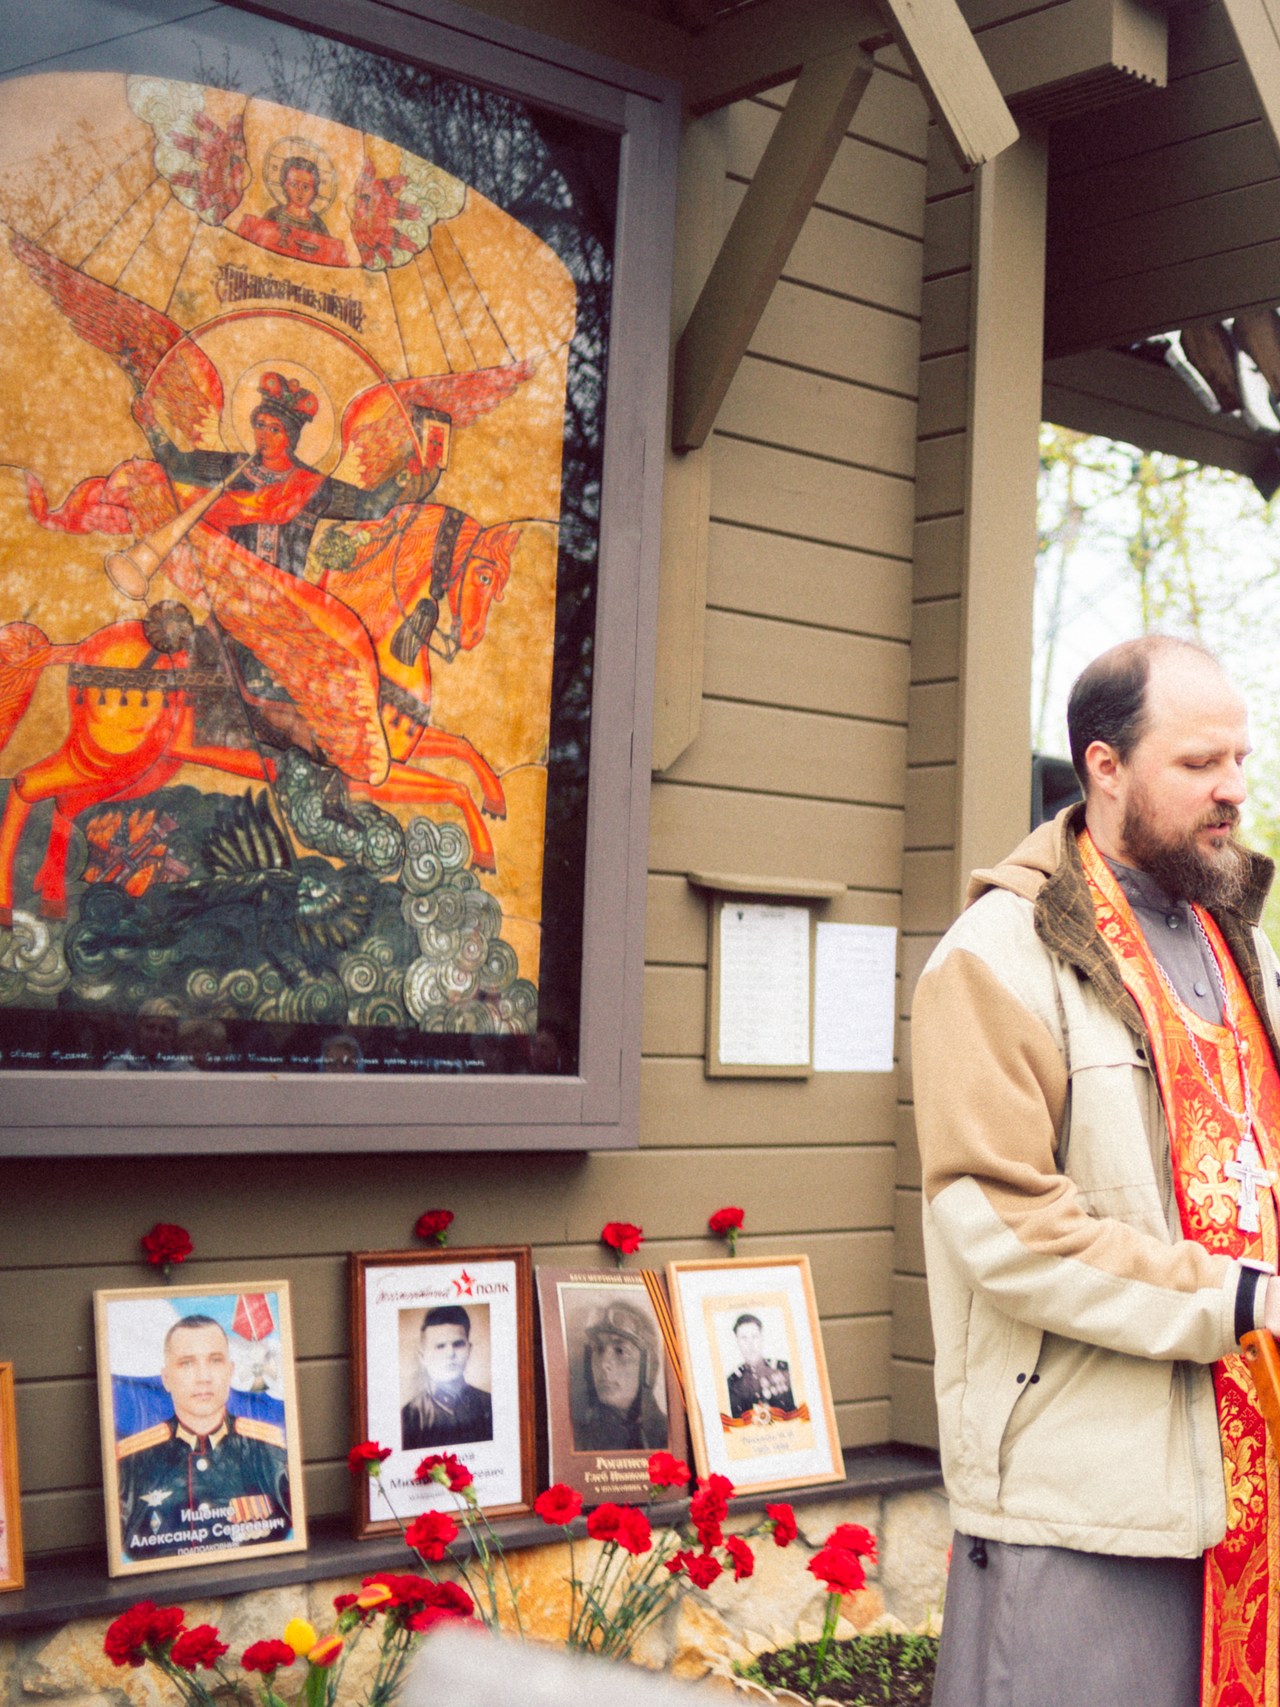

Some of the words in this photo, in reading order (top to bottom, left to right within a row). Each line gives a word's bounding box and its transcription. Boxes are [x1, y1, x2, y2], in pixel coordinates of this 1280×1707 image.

[180, 1505, 236, 1524] Ищенко
[130, 1527, 209, 1549] Александр
[211, 1517, 286, 1538] Сергеевич
